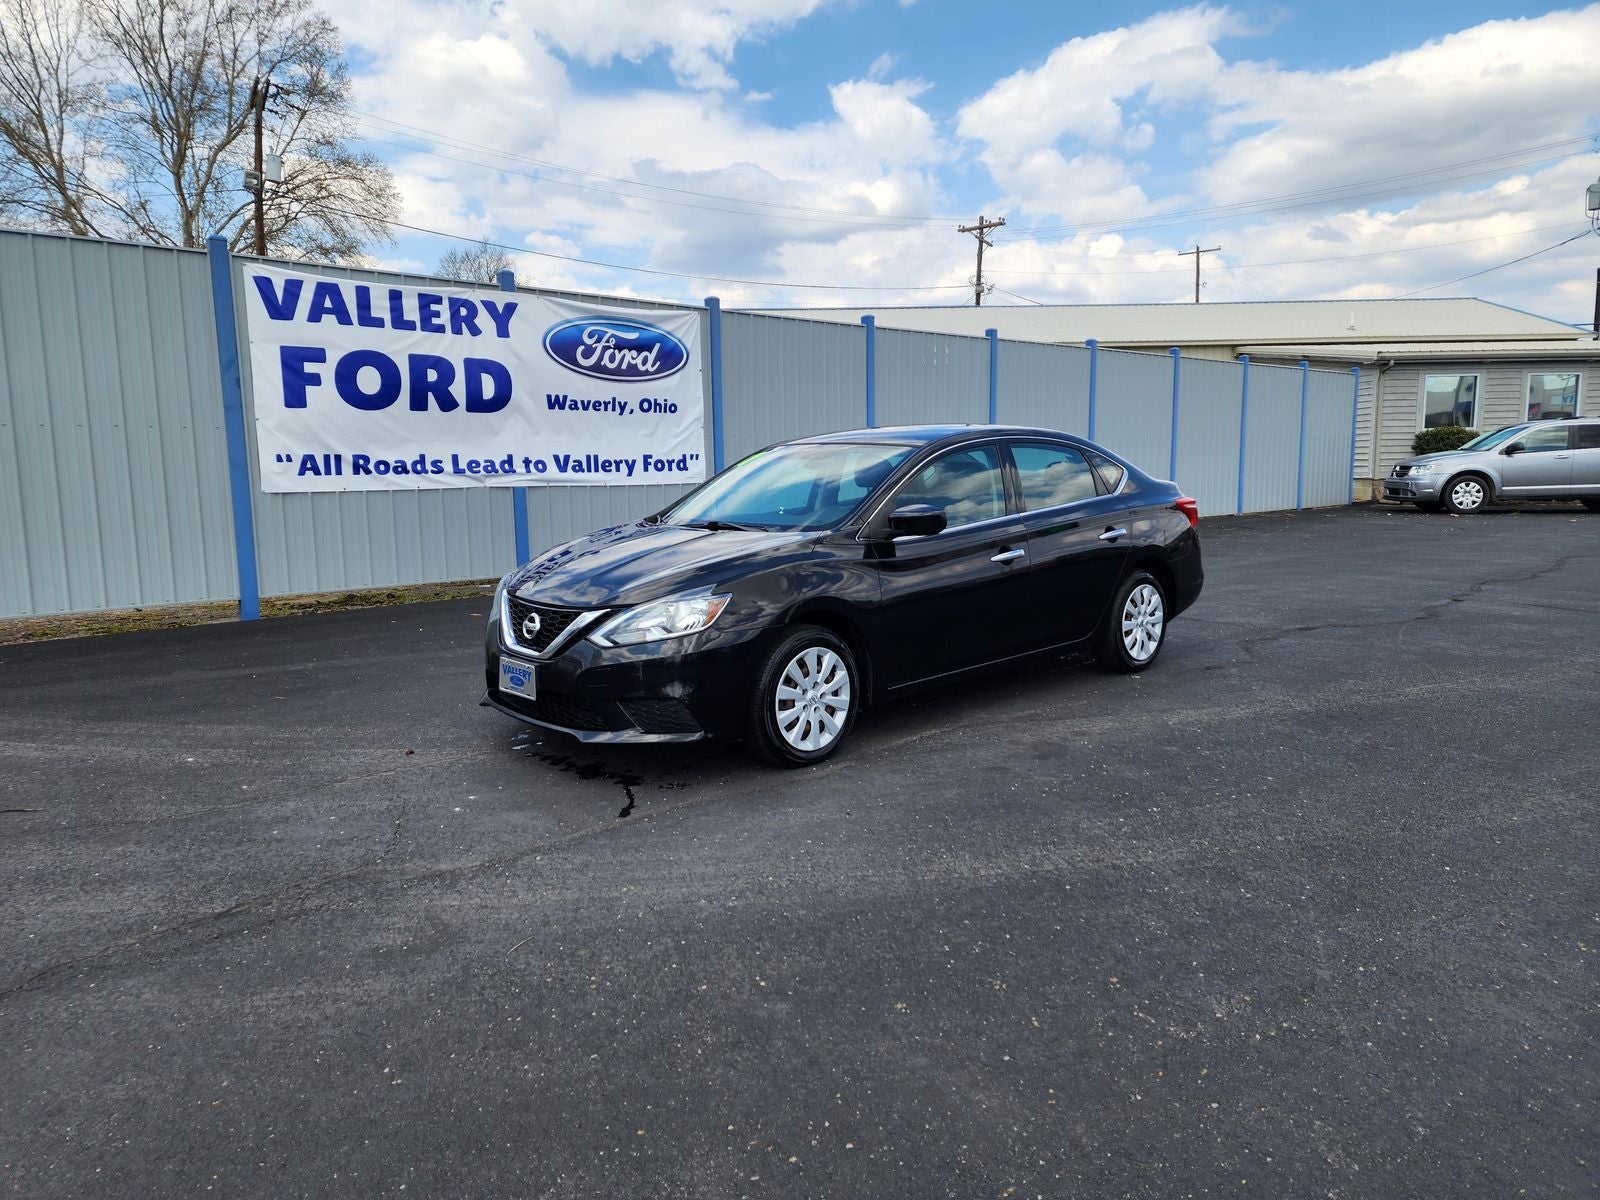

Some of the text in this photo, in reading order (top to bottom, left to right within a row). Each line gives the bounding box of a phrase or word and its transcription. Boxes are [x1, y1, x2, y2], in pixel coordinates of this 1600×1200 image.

[252, 275, 518, 338] VALLERY
[575, 325, 661, 372] Ford
[280, 345, 513, 413] FORD
[546, 394, 678, 416] Waverly, Ohio
[352, 454, 444, 475] Roads
[451, 454, 515, 475] Lead
[523, 456, 548, 474] to
[553, 454, 637, 477] Vallery
[502, 662, 532, 683] VALLERY
